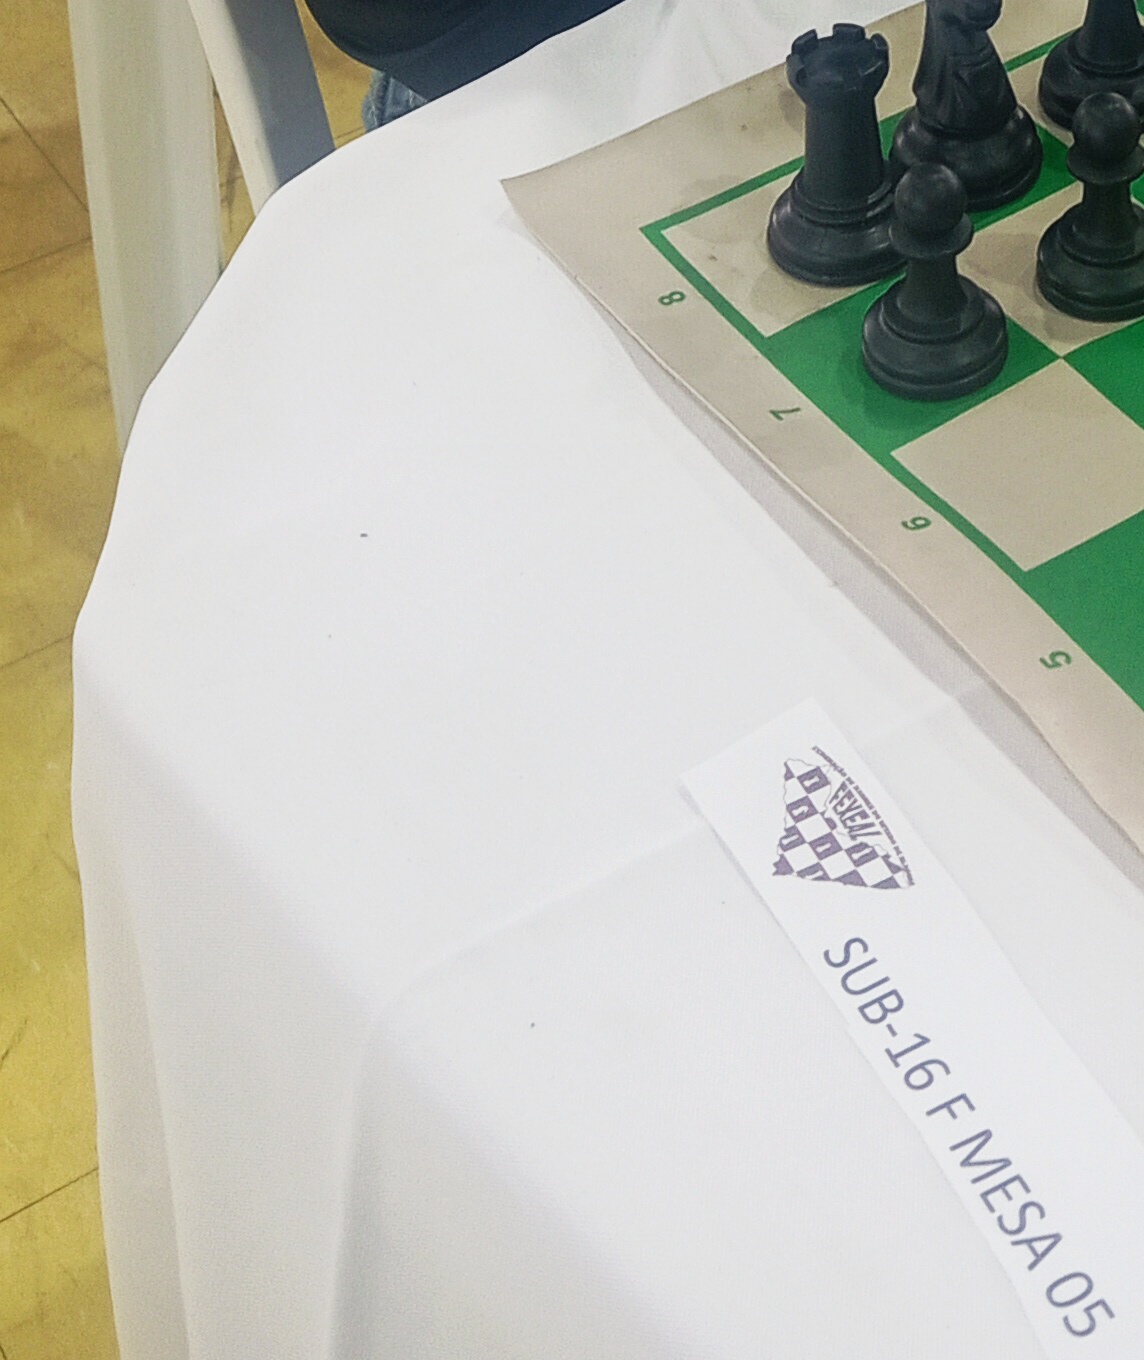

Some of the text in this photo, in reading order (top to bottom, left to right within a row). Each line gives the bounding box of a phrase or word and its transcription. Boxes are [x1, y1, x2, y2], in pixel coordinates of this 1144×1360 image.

[657, 289, 686, 307] 8
[768, 406, 802, 422] 7
[900, 515, 932, 531] 6
[1039, 650, 1072, 670] 5
[828, 780, 882, 841] FEXEAL
[823, 937, 951, 1091] SUB-16
[925, 1093, 976, 1120] F
[949, 1129, 1062, 1271] MESA
[1045, 1271, 1115, 1337] 05
